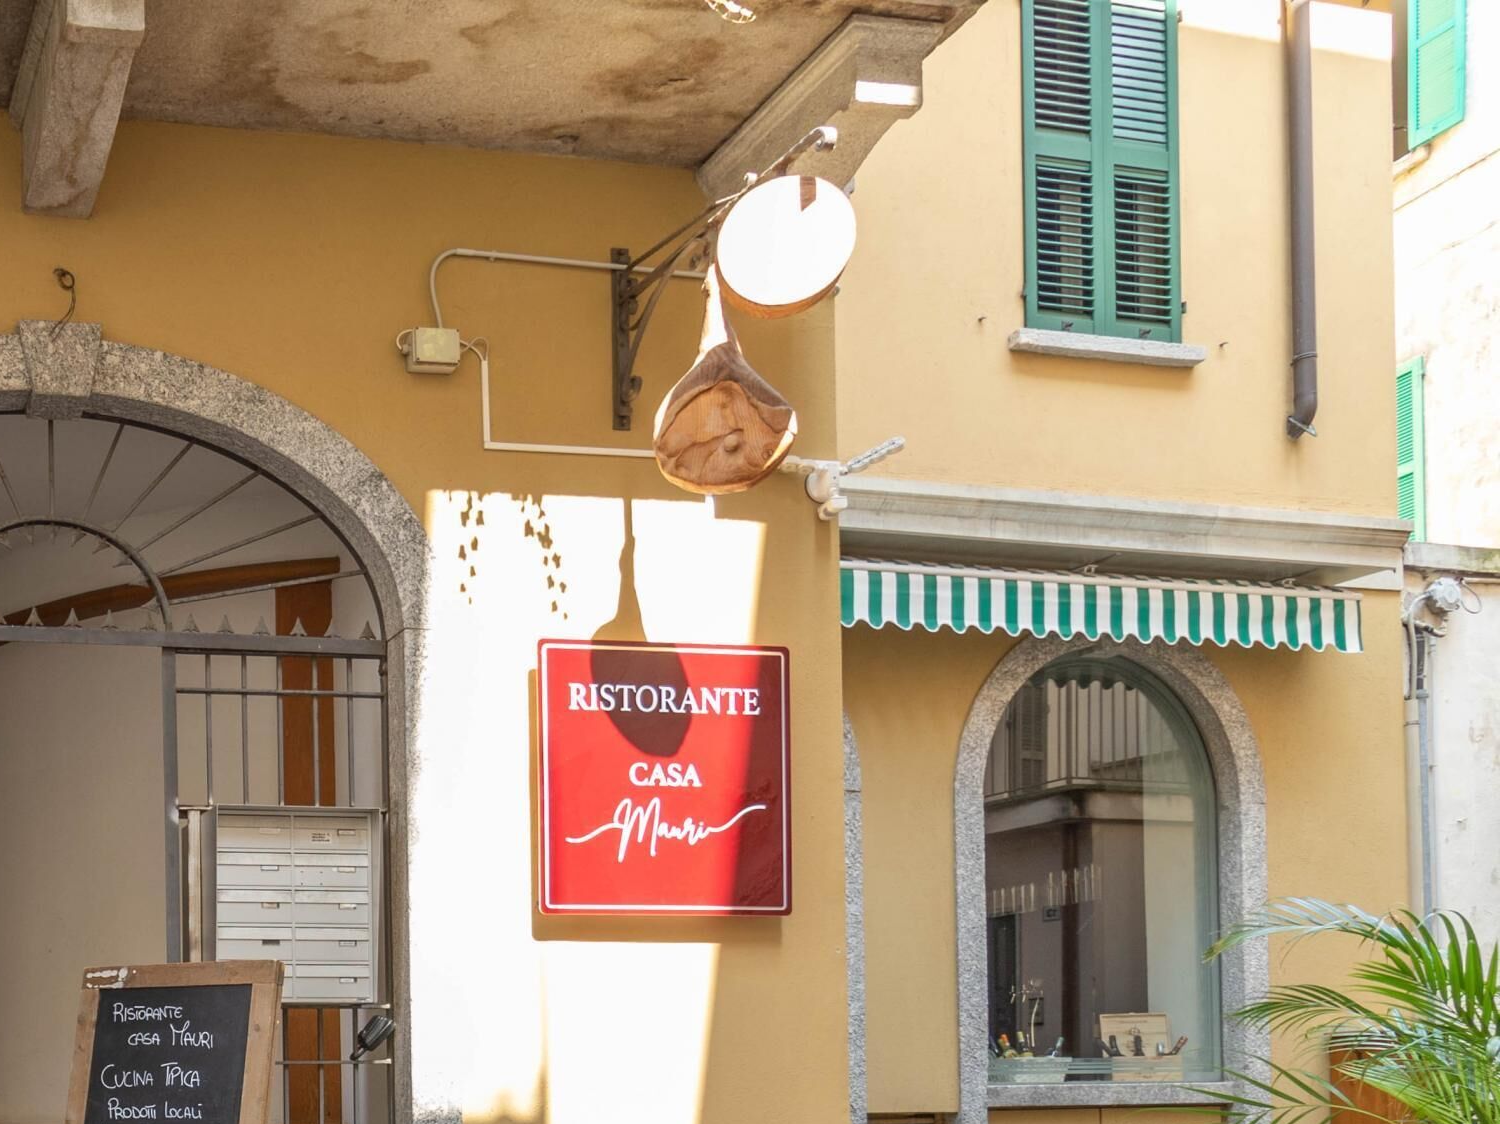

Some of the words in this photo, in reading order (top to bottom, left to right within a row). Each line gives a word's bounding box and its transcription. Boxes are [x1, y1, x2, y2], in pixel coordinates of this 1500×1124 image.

[567, 682, 761, 716] RISTORANTE
[628, 761, 703, 788] CASA
[565, 796, 767, 864] Mauri
[112, 1002, 183, 1023] RISTORANTE
[127, 1032, 161, 1046] CASA
[169, 1020, 214, 1049] MAURI
[100, 1063, 154, 1089] CUCINA
[160, 1062, 201, 1088] TIPICA
[107, 1097, 157, 1120] PRODOTTI
